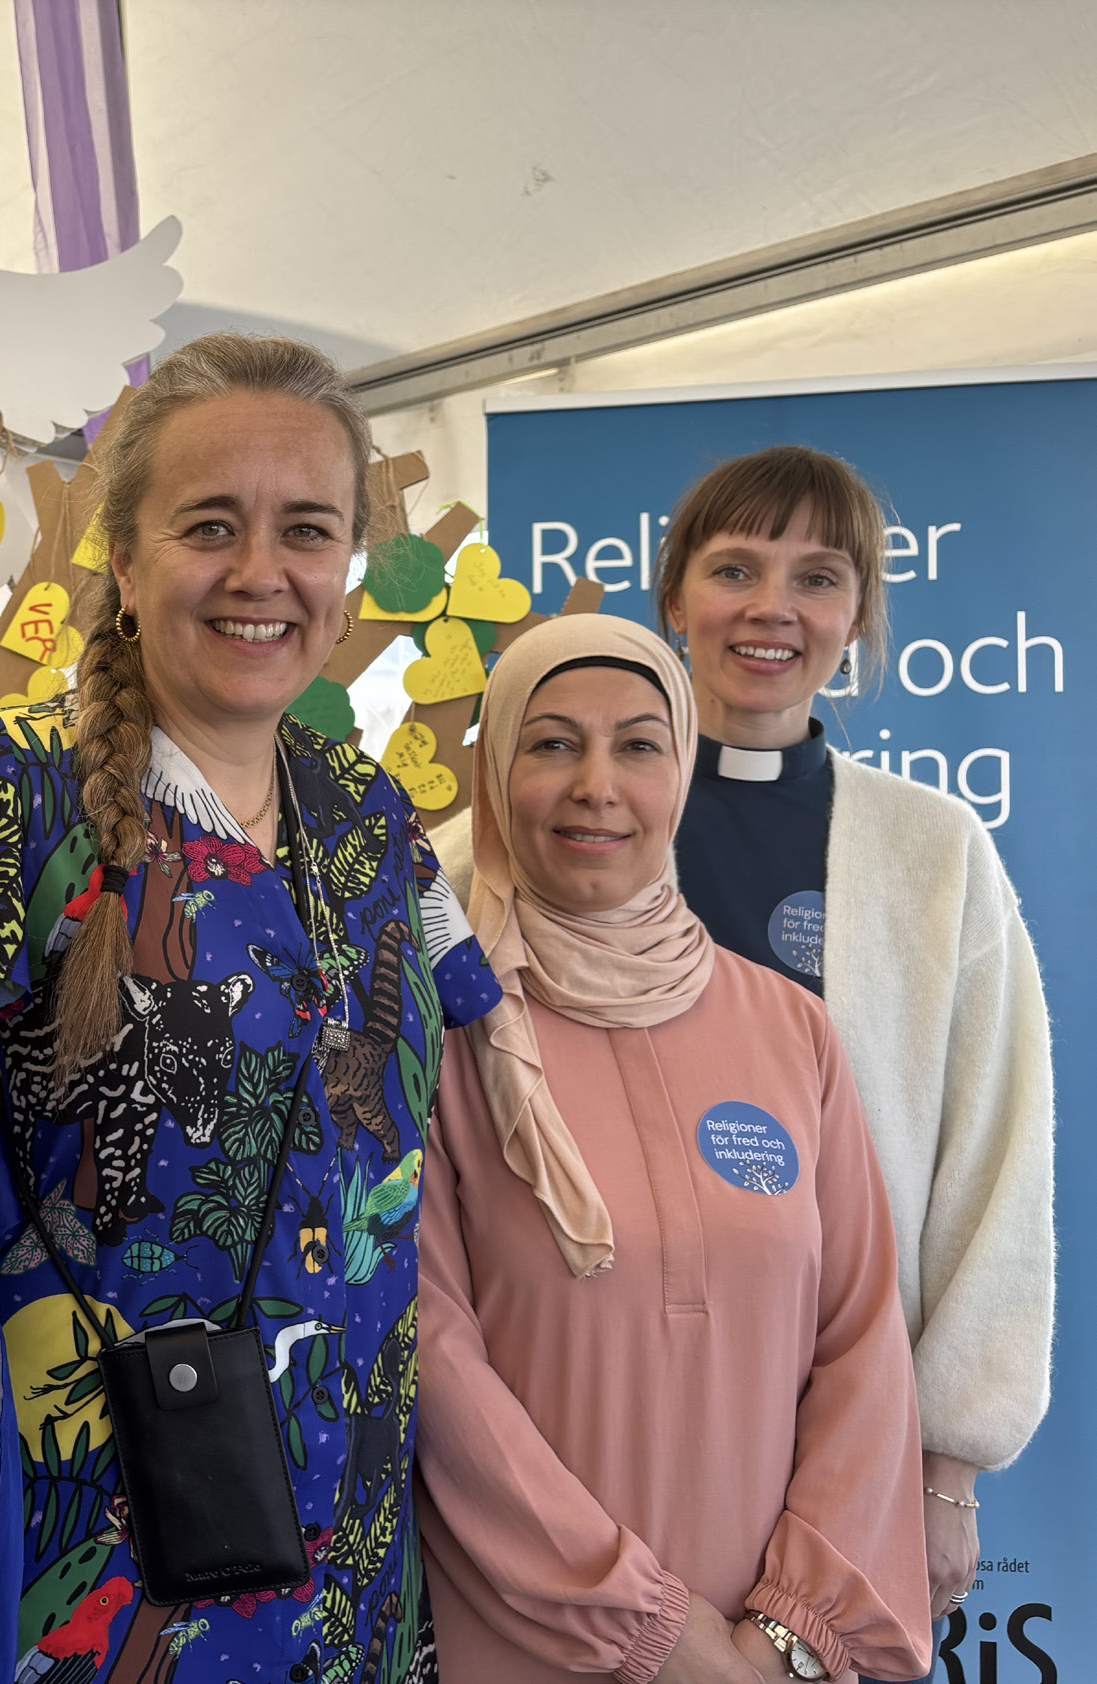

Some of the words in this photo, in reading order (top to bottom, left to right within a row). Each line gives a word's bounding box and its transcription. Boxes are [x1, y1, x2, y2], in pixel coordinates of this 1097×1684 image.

[898, 611, 1064, 697] och
[783, 905, 824, 920] Religio
[783, 917, 801, 929] för
[706, 1120, 767, 1134] Religioner
[710, 1134, 729, 1146] för
[732, 1134, 760, 1147] fred
[761, 1138, 786, 1151] och
[714, 1148, 785, 1167] inkludering
[996, 1557, 1030, 1574] rådet
